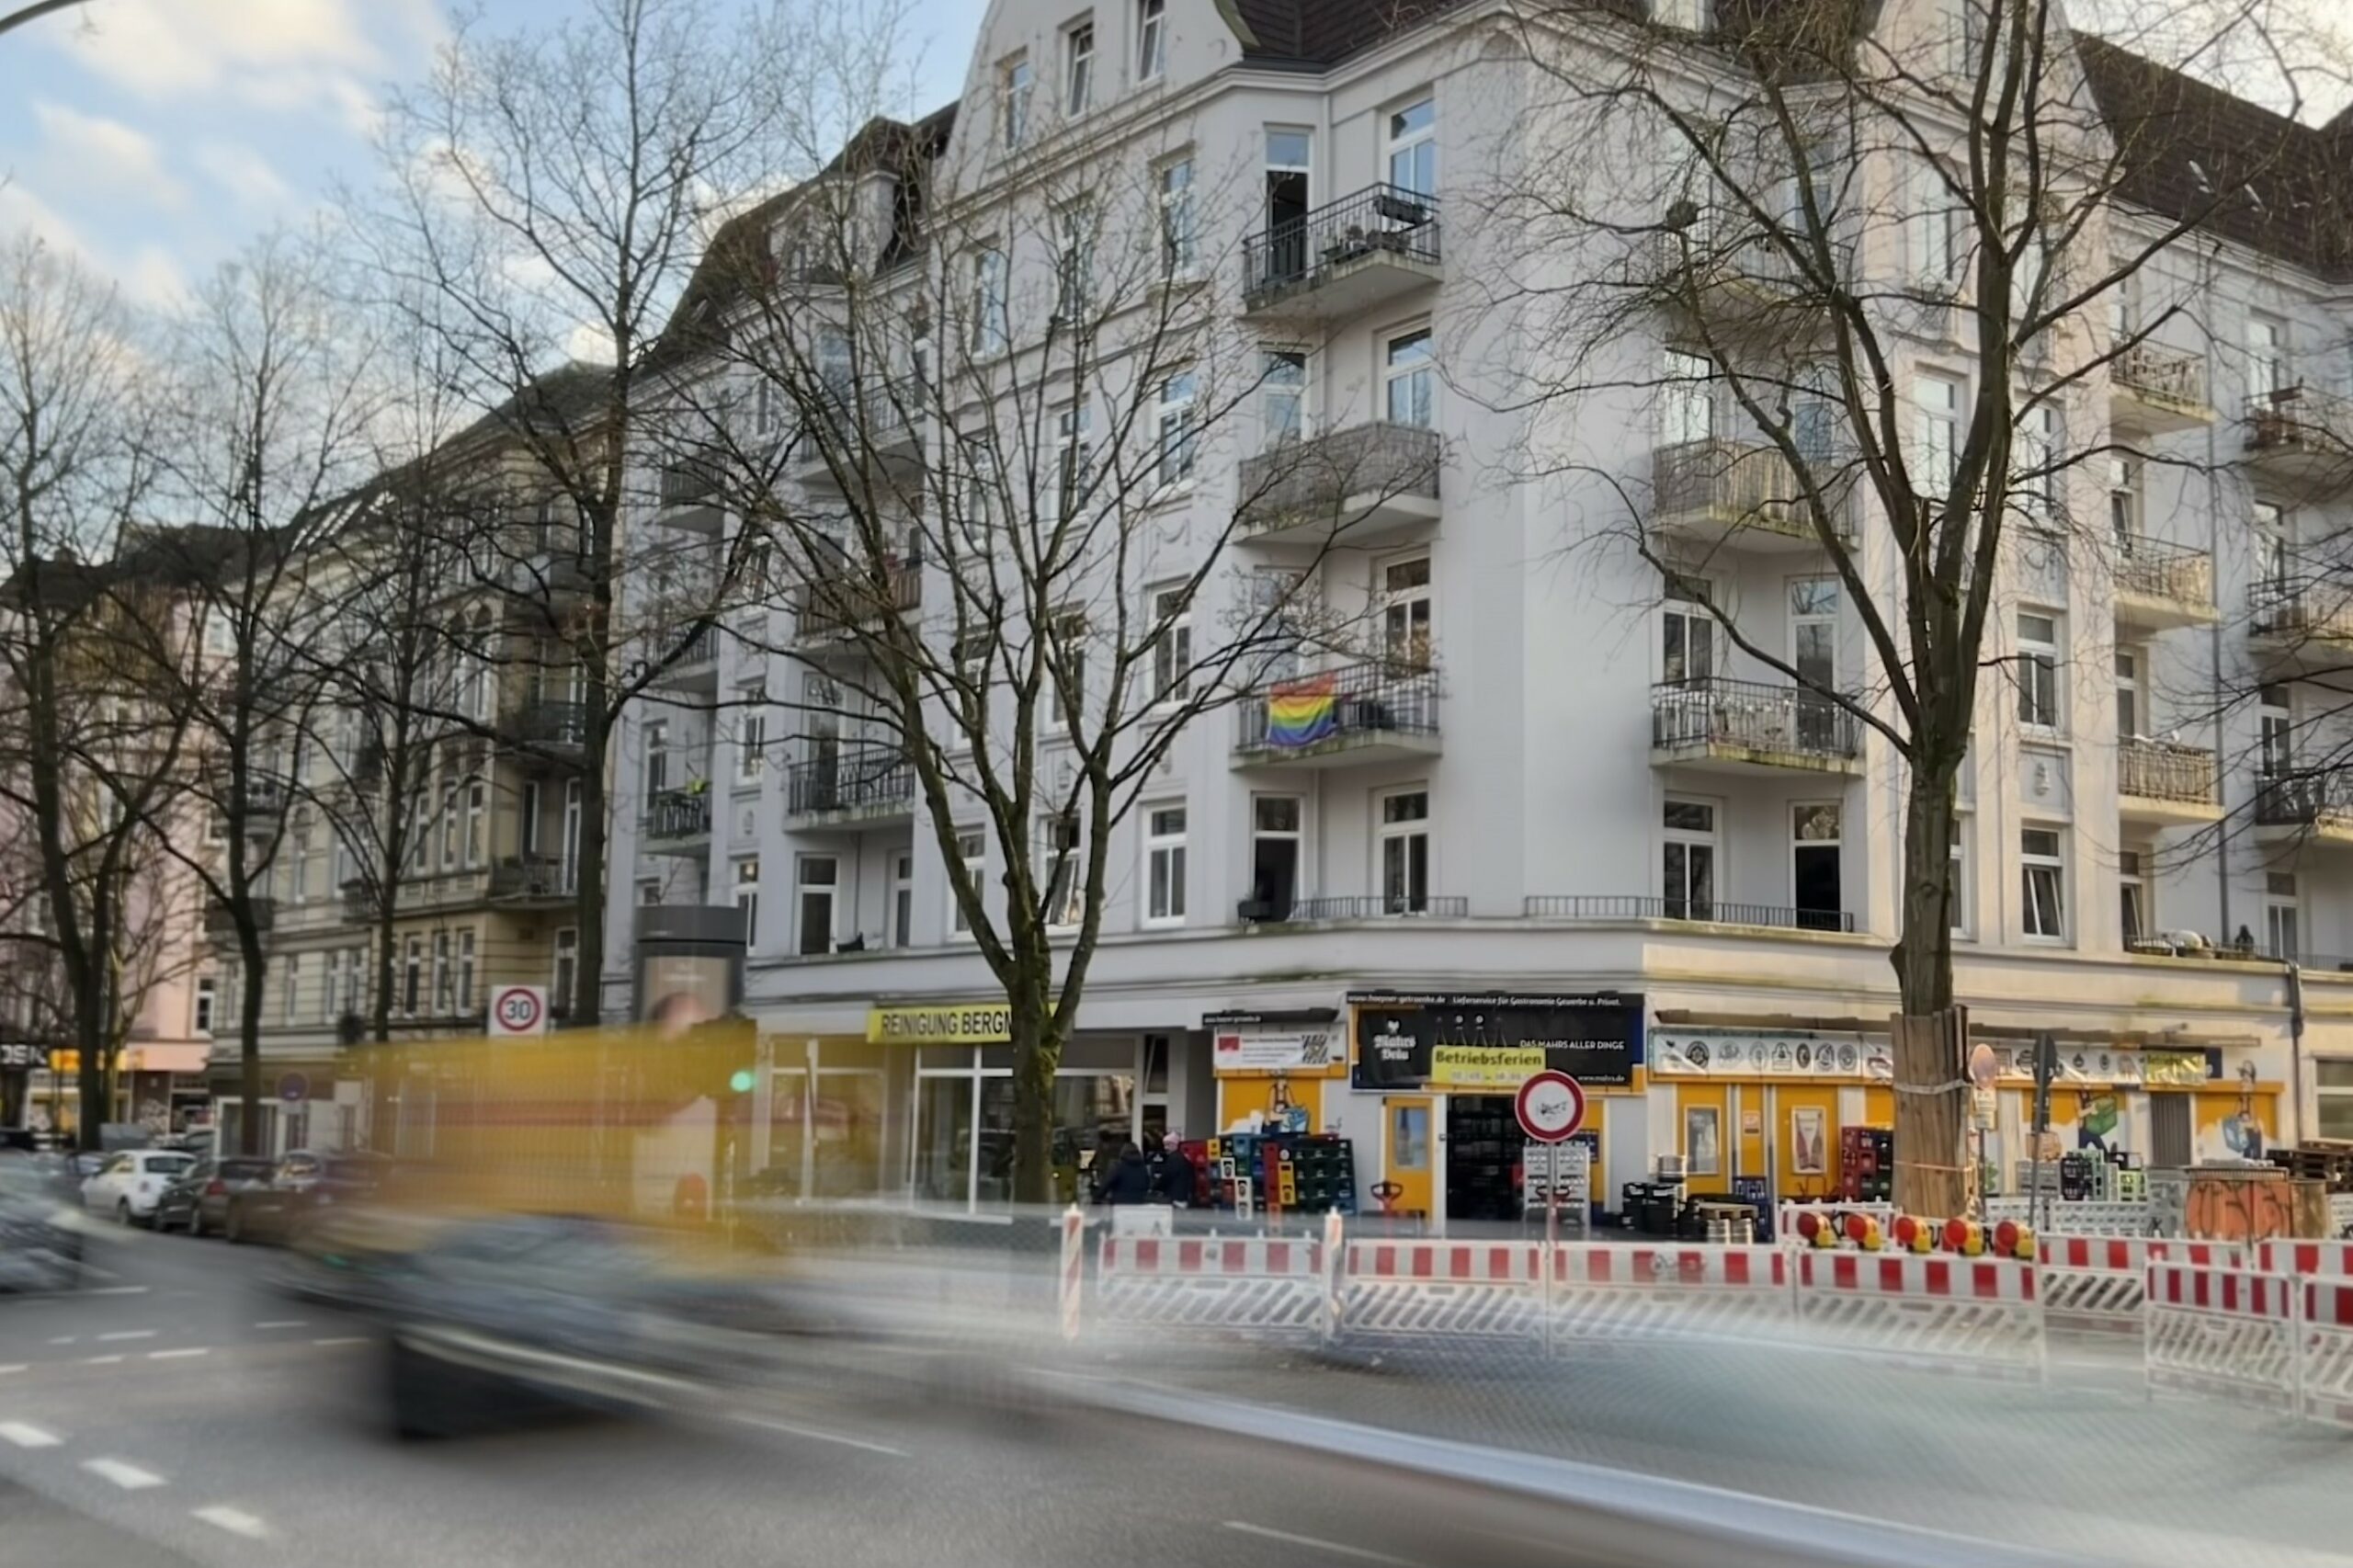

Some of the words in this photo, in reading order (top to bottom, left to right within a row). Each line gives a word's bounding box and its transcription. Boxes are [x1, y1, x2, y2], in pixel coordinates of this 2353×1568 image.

[1452, 996, 1496, 1006] Lieferservice
[1510, 996, 1555, 1006] Gastronomie
[1556, 996, 1587, 1006] Gewerbe
[506, 1000, 530, 1020] 30
[881, 1013, 958, 1036] REINIGUNG
[1519, 1040, 1537, 1048] DAS
[1538, 1040, 1568, 1049] MAHRS
[1569, 1040, 1597, 1050] ALLER
[1597, 1040, 1625, 1051] DINGE
[1436, 1051, 1541, 1066] Betriebsferien
